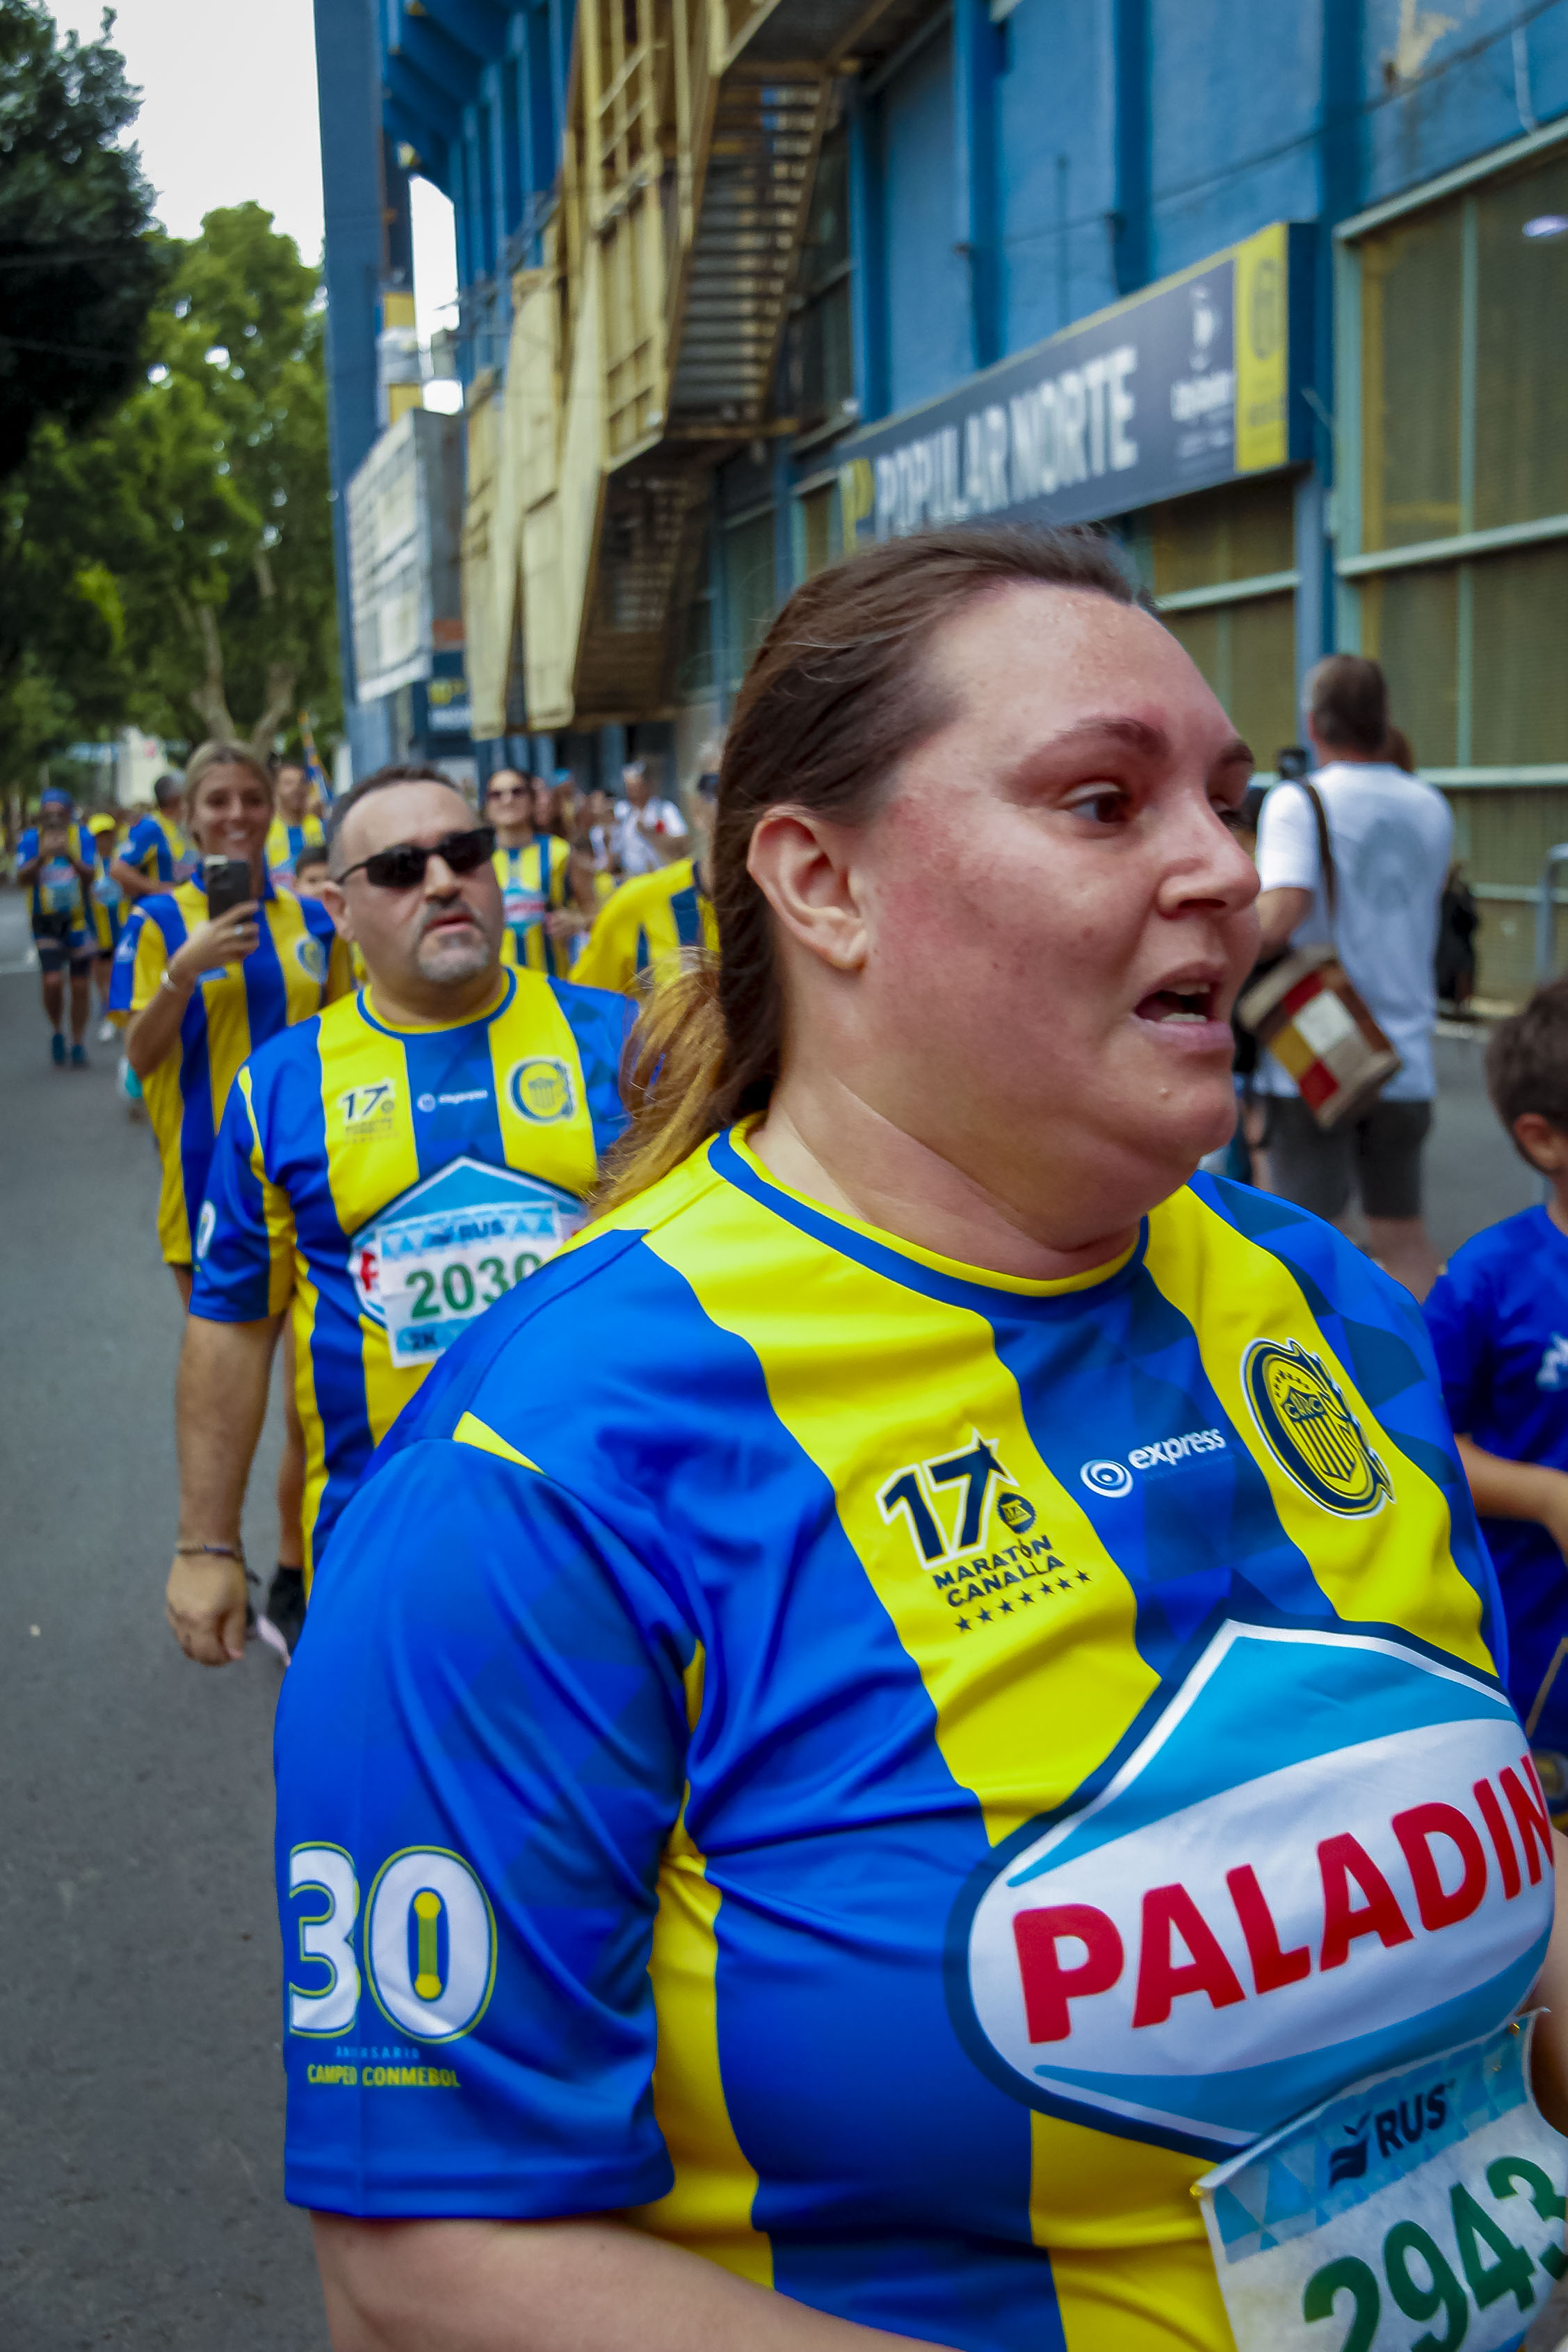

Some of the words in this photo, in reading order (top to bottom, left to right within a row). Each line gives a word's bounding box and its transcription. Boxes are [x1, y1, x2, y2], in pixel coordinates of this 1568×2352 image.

[875, 405, 1008, 545] POPULAR
[1010, 346, 1138, 497] NORTE
[339, 1081, 391, 1122] 17
[405, 1252, 541, 1319] 2030
[1128, 1428, 1227, 1469] express
[879, 1434, 1014, 1568] 17
[947, 1554, 1065, 1608] CANALLA
[289, 1842, 498, 2045] 30
[362, 2066, 462, 2087] CONMEBOL
[1374, 2083, 1448, 2159] RUS
[1302, 2156, 1568, 2352] 2943
